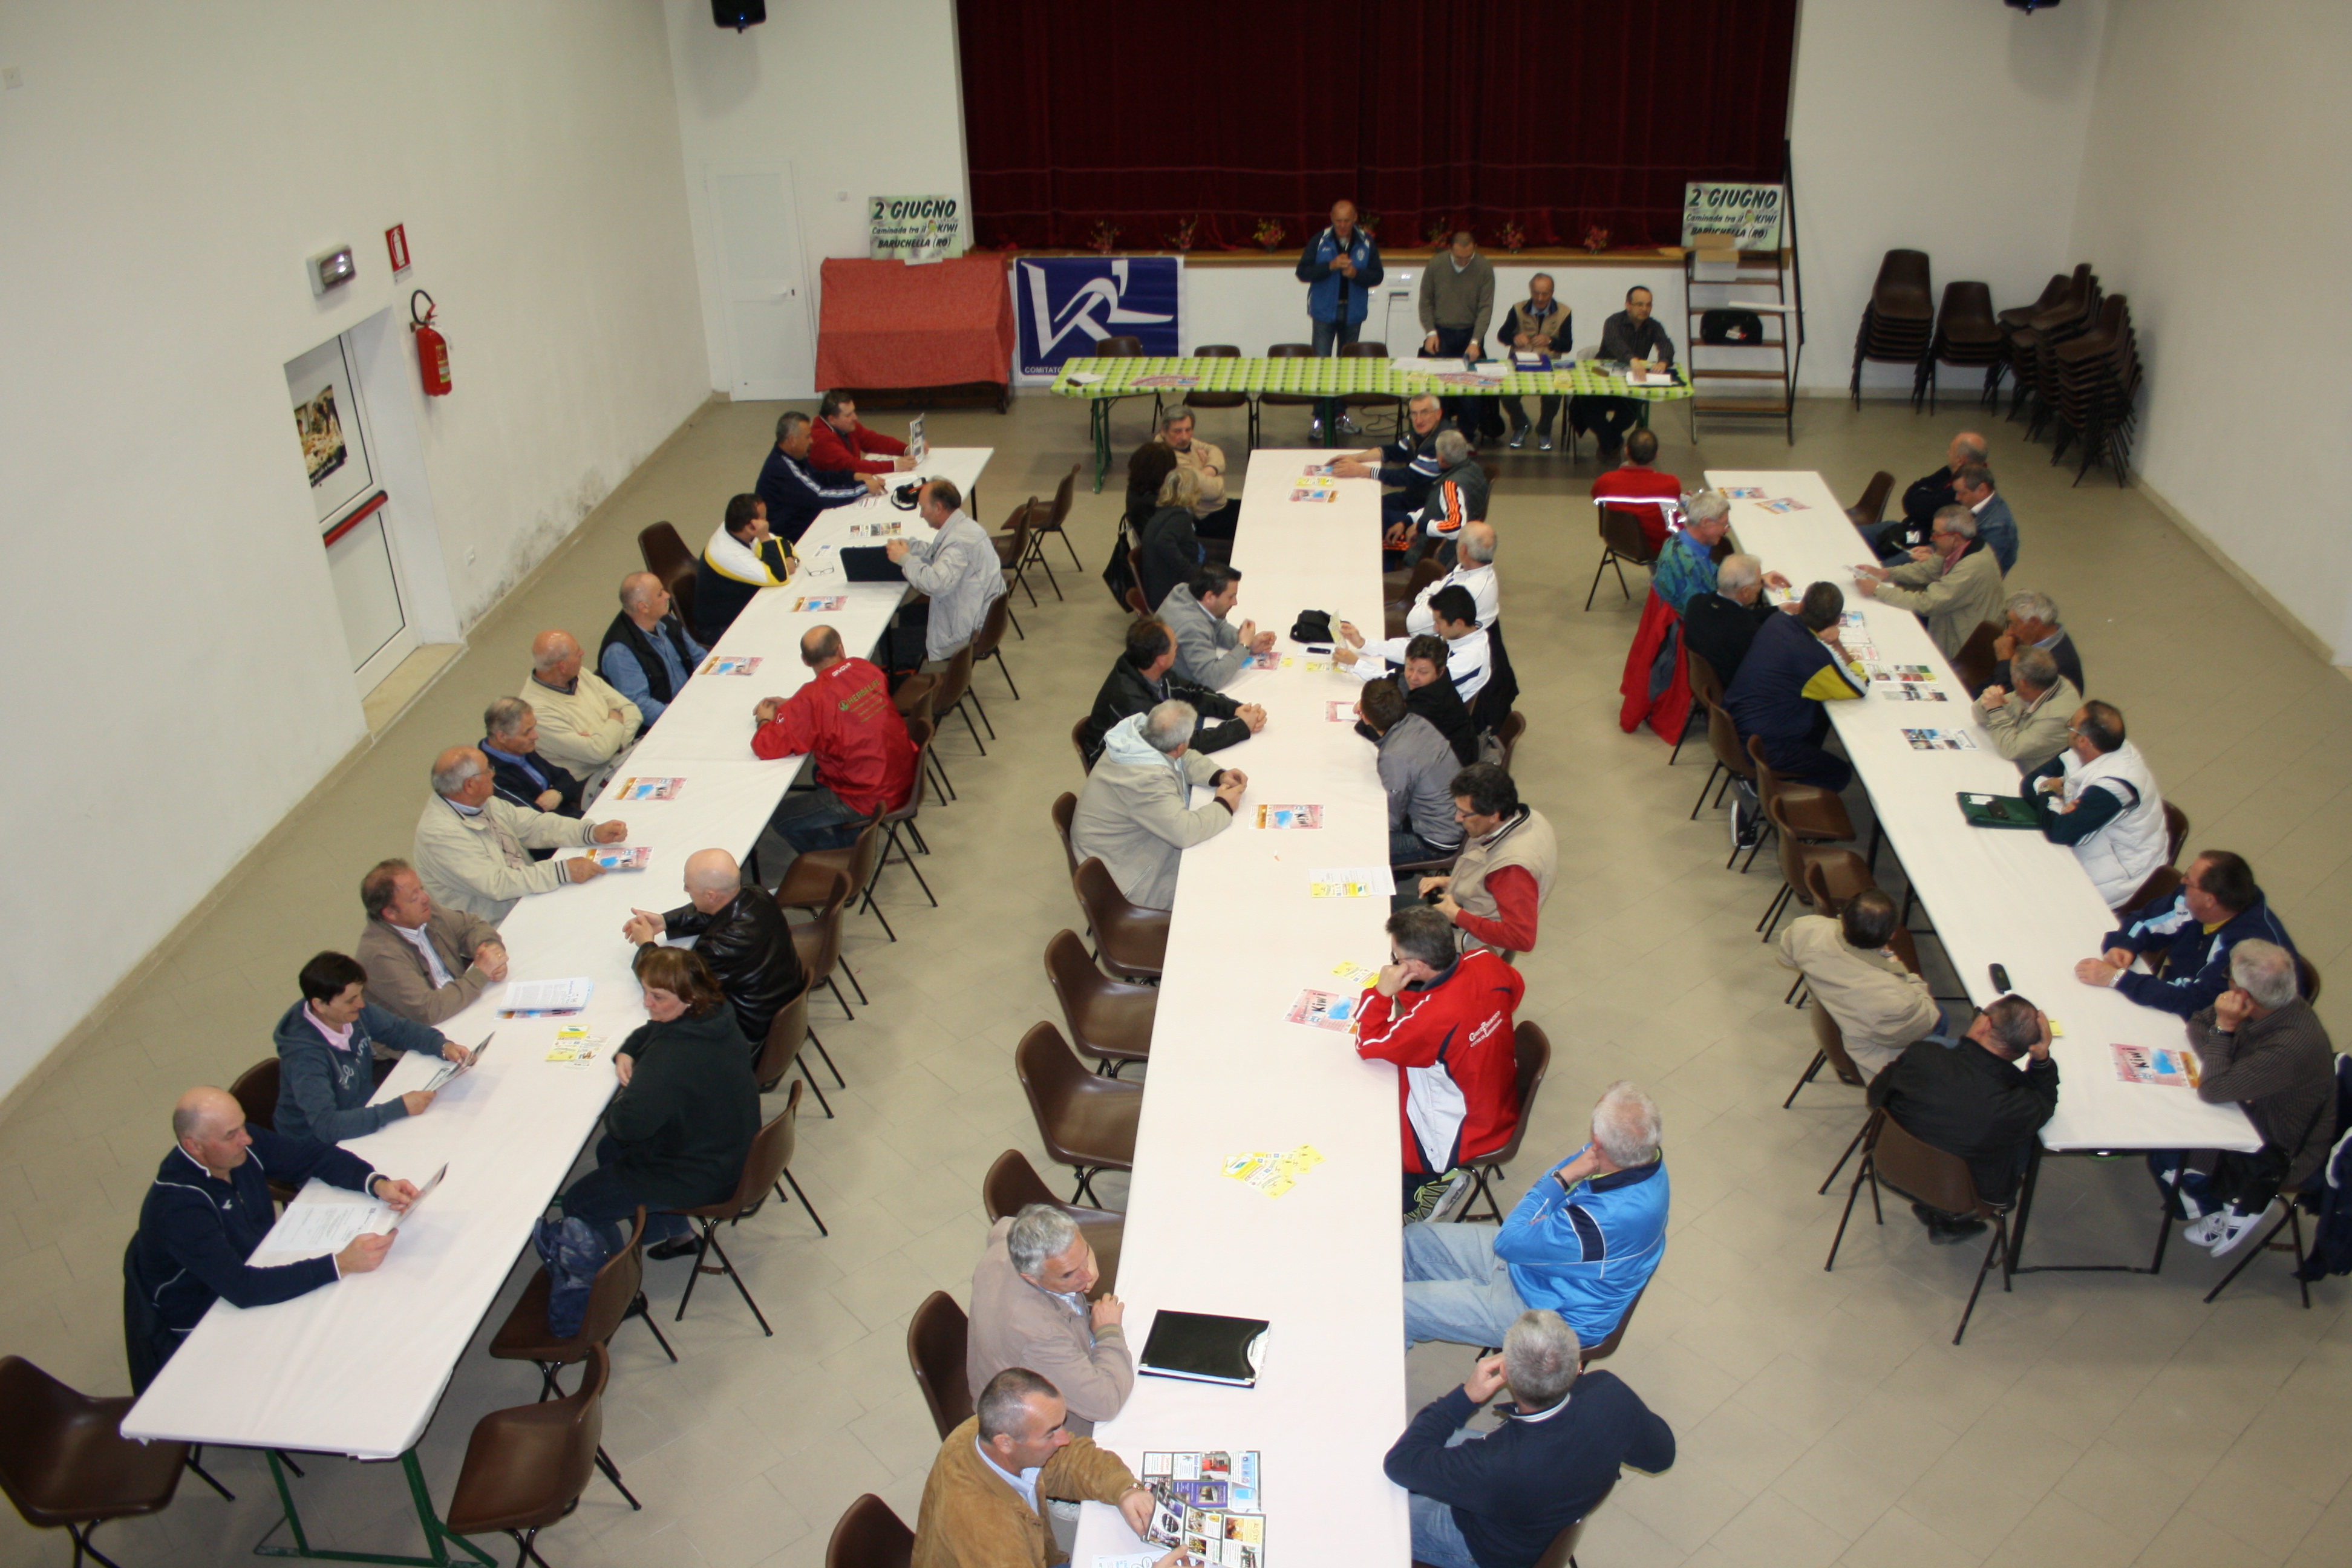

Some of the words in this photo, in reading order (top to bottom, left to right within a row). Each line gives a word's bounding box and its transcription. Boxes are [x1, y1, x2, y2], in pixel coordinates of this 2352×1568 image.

[1689, 189, 1702, 206] 2
[1707, 188, 1777, 209] GIUGNO
[873, 201, 884, 220] 2
[890, 200, 956, 220] GIUGNO
[1687, 214, 1722, 222] Caminada
[1755, 215, 1777, 223] KIWI
[921, 224, 927, 233] il
[937, 223, 958, 232] KIWI
[1748, 227, 1768, 238] (RO)
[878, 238, 930, 248] BARUCHELLA
[933, 237, 951, 248] (RO)
[847, 679, 881, 705] HERBALIFE
